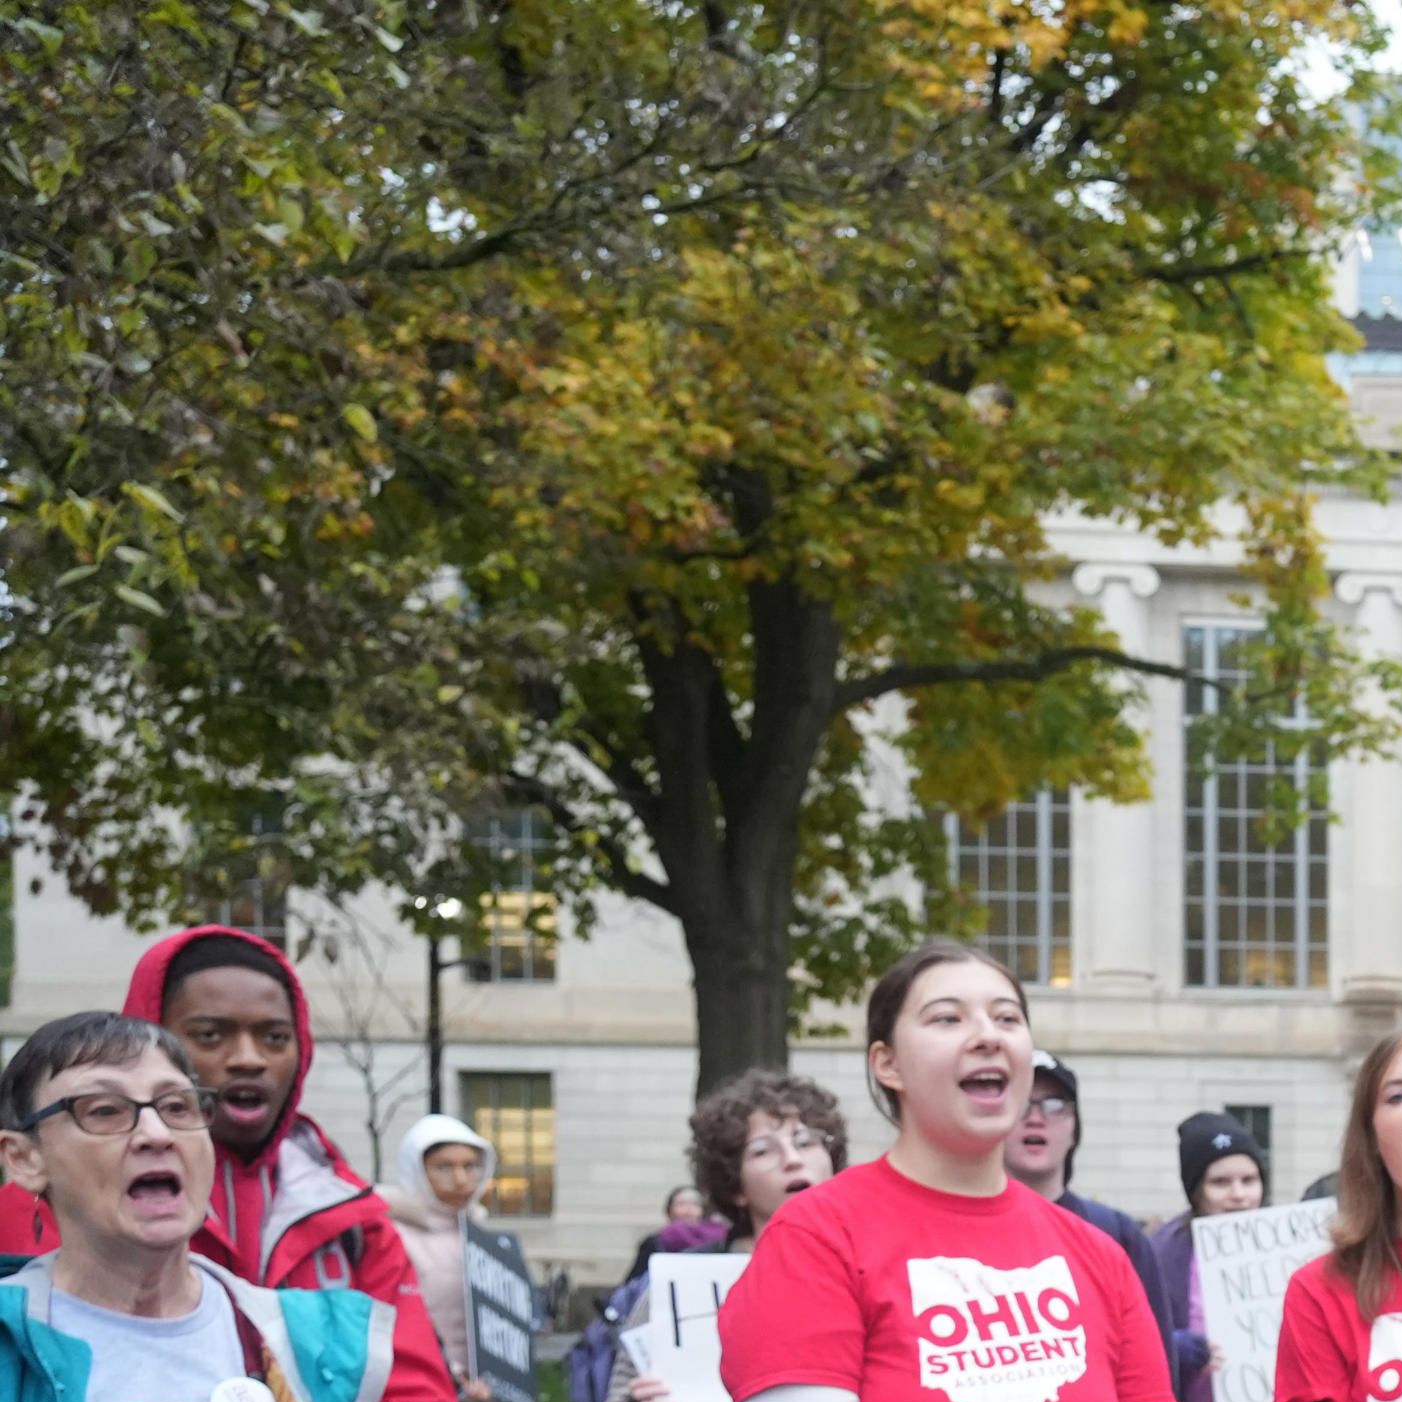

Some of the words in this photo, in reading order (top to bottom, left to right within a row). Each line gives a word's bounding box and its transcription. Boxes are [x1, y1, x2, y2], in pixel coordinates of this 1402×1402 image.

[1220, 1251, 1316, 1304] NEED
[914, 1288, 1082, 1347] OHIO
[926, 1336, 1081, 1375] STUDENT
[954, 1361, 1082, 1389] ASSOCIATION
